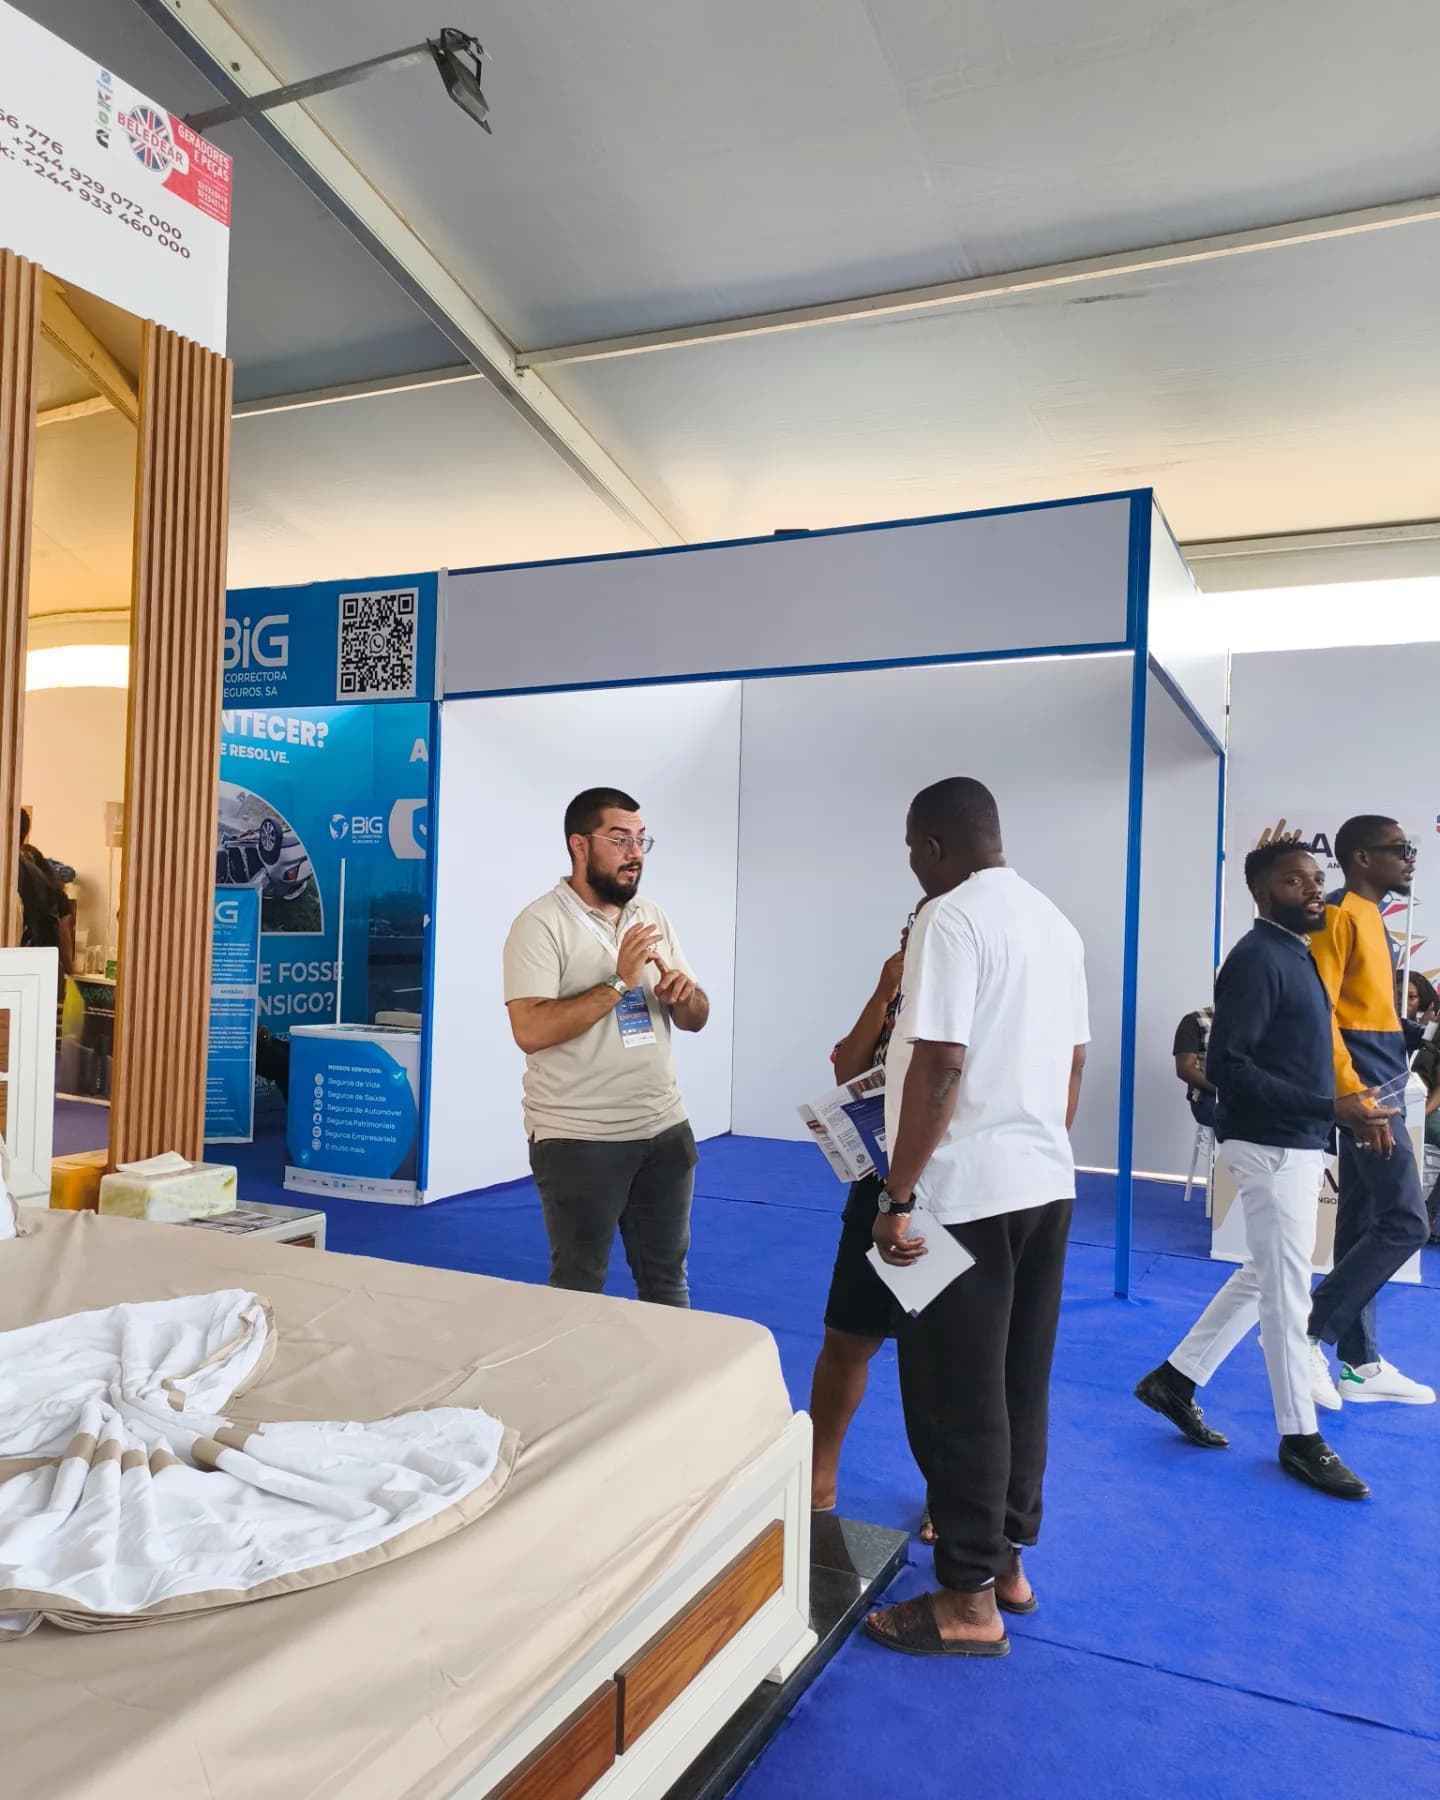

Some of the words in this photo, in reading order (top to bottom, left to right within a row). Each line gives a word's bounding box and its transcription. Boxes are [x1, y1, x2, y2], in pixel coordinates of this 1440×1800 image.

[25, 124, 63, 155] 776
[117, 111, 184, 166] BELEDEAR
[177, 124, 230, 170] GERADORES
[201, 156, 230, 182] PEÇAS
[12, 136, 64, 171] +244
[70, 167, 105, 194] 929
[111, 191, 144, 218] 072
[149, 213, 182, 240] 000
[22, 159, 73, 192] +244
[79, 188, 113, 215] 933
[118, 213, 153, 237] 460
[158, 234, 190, 259] 000
[224, 671, 288, 683] CORRECTORA
[265, 685, 278, 697] SA
[221, 709, 329, 749] NTECER?
[220, 743, 227, 756] E
[229, 743, 290, 765] RESOLVE.
[409, 738, 429, 762] A
[351, 816, 383, 834] BiG
[1311, 833, 1333, 858] A
[1327, 862, 1341, 870] AN
[215, 900, 239, 924] G
[258, 962, 272, 985] E
[279, 960, 344, 984] FOSSE
[256, 991, 335, 1017] NSIGO?
[365, 1080, 381, 1089] Vida
